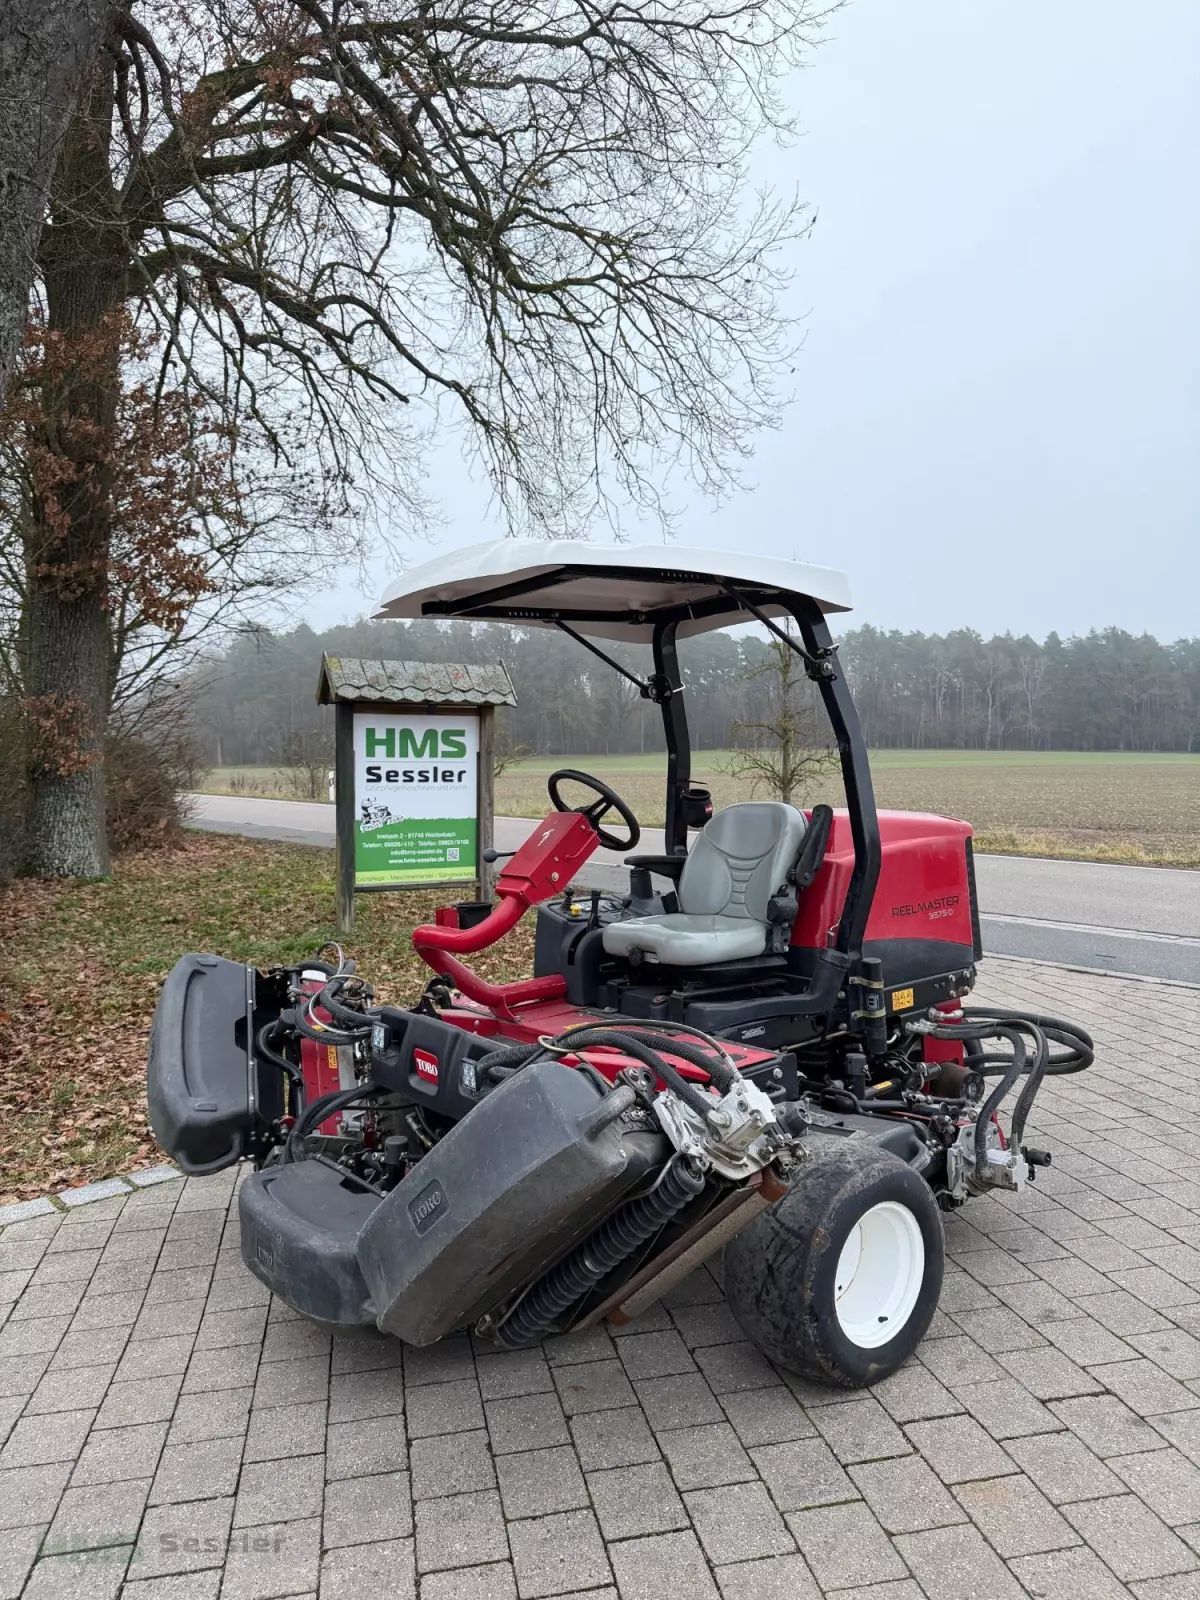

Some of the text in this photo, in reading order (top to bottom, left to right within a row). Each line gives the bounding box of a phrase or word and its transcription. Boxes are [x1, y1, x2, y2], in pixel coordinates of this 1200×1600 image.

[365, 727, 467, 759] HMS
[366, 766, 467, 783] Sessler
[892, 896, 959, 918] REELMASTER
[416, 1058, 438, 1077] TORO
[413, 1191, 442, 1225] TORO
